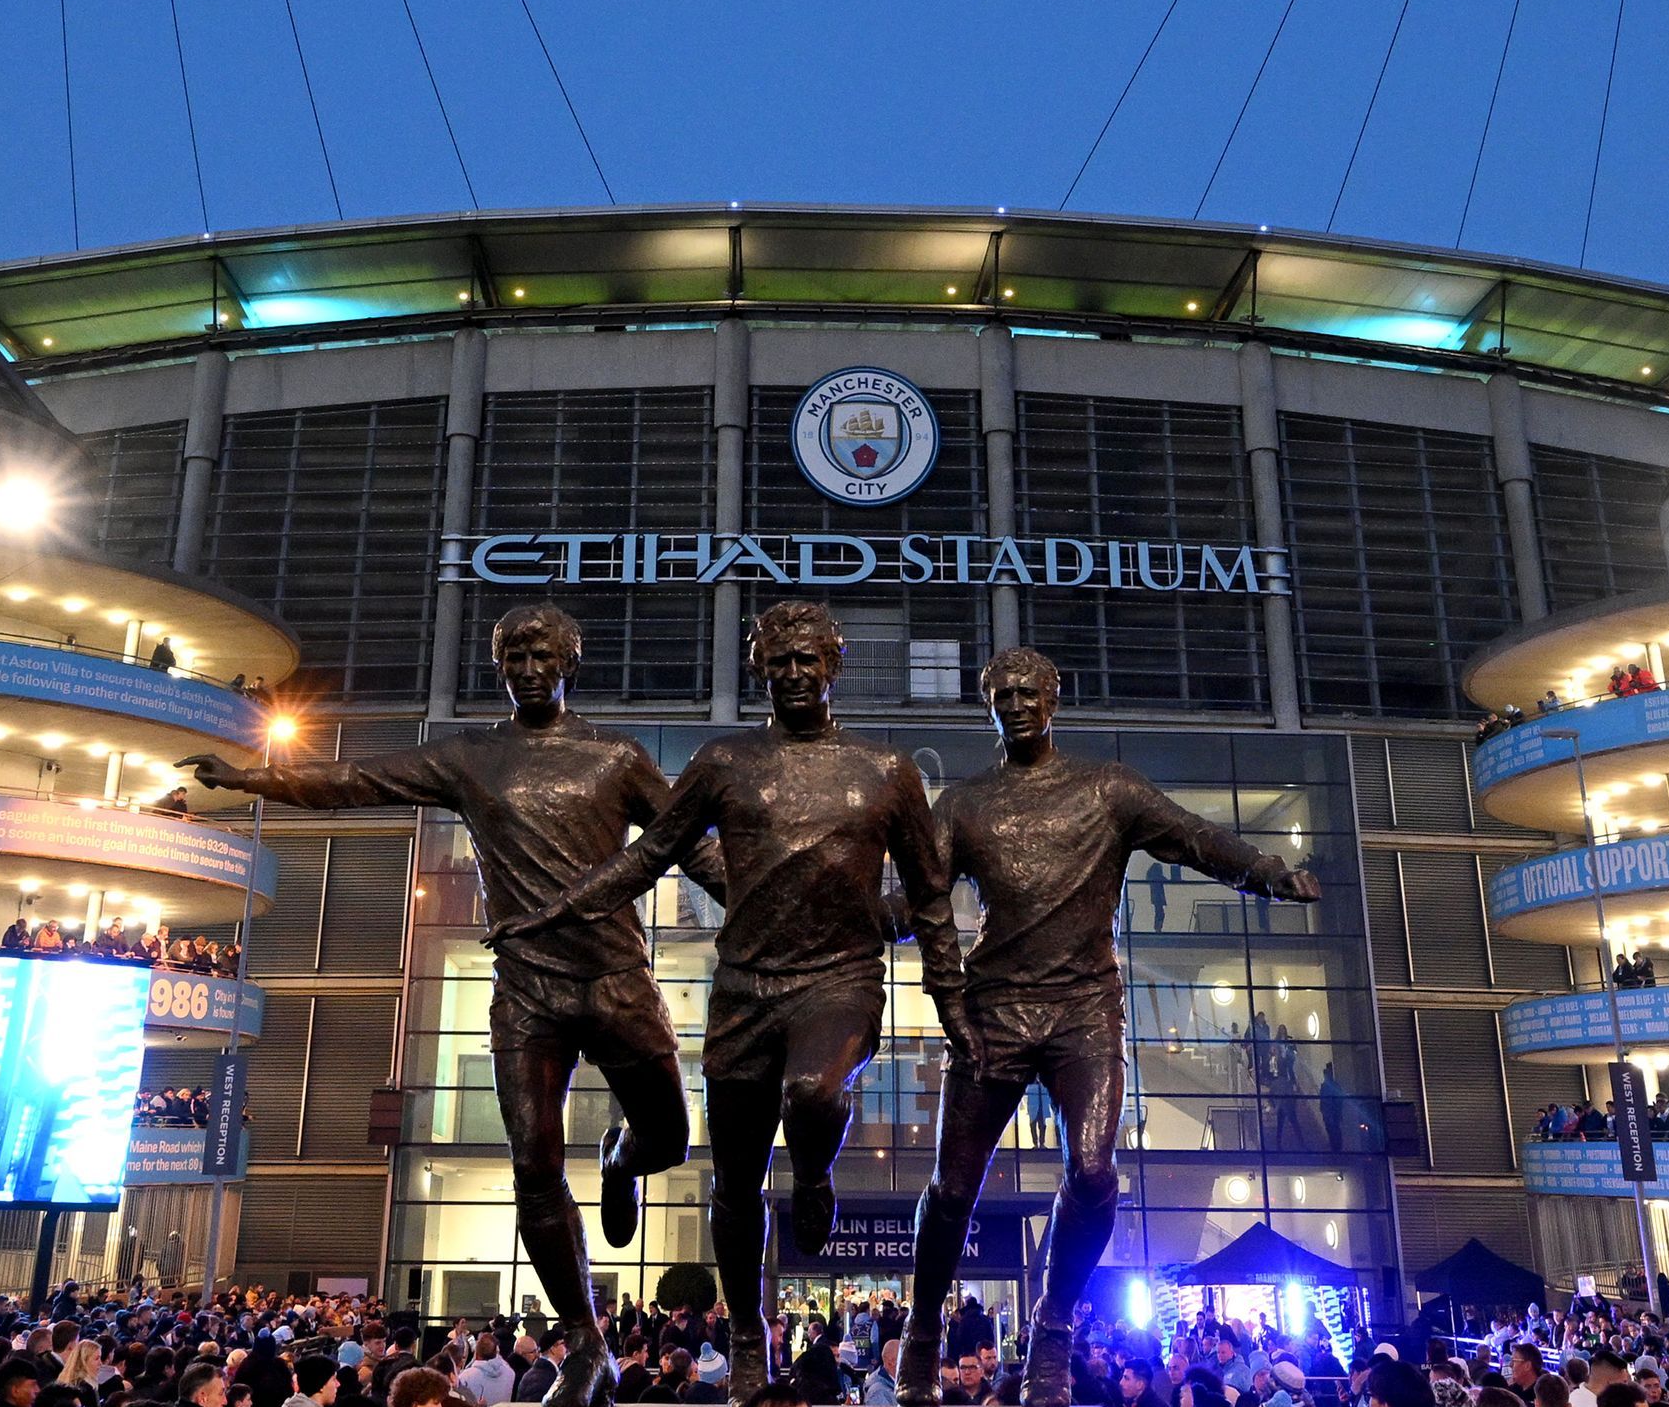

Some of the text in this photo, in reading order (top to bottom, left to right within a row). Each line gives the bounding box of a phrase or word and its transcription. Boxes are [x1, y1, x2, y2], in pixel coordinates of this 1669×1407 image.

[807, 377, 923, 419] MANCHESTER
[802, 431, 813, 439] 18
[845, 483, 887, 495] CITY
[471, 534, 1260, 593] ETIHAD STADIUM
[9, 656, 48, 671] Aston
[52, 660, 78, 677] Villa
[81, 667, 93, 679] to
[95, 672, 132, 688] secure
[135, 678, 152, 691] the
[12, 672, 72, 694] following
[73, 684, 120, 701] another
[120, 692, 166, 711] dramatic
[61, 814, 82, 828] the
[84, 817, 109, 832] first
[8, 829, 45, 842] score
[47, 832, 64, 844] an
[66, 832, 101, 848] iconic
[1523, 855, 1582, 904] OFFICIAL
[149, 979, 209, 1020] 986
[215, 1064, 235, 1165] WEST RECEPTION
[1622, 1072, 1643, 1171] WEST RECEPTION
[159, 1141, 180, 1154] Road
[170, 1160, 187, 1171] next
[832, 1219, 916, 1234] OLIN BELL
[819, 1243, 868, 1256] WEST
